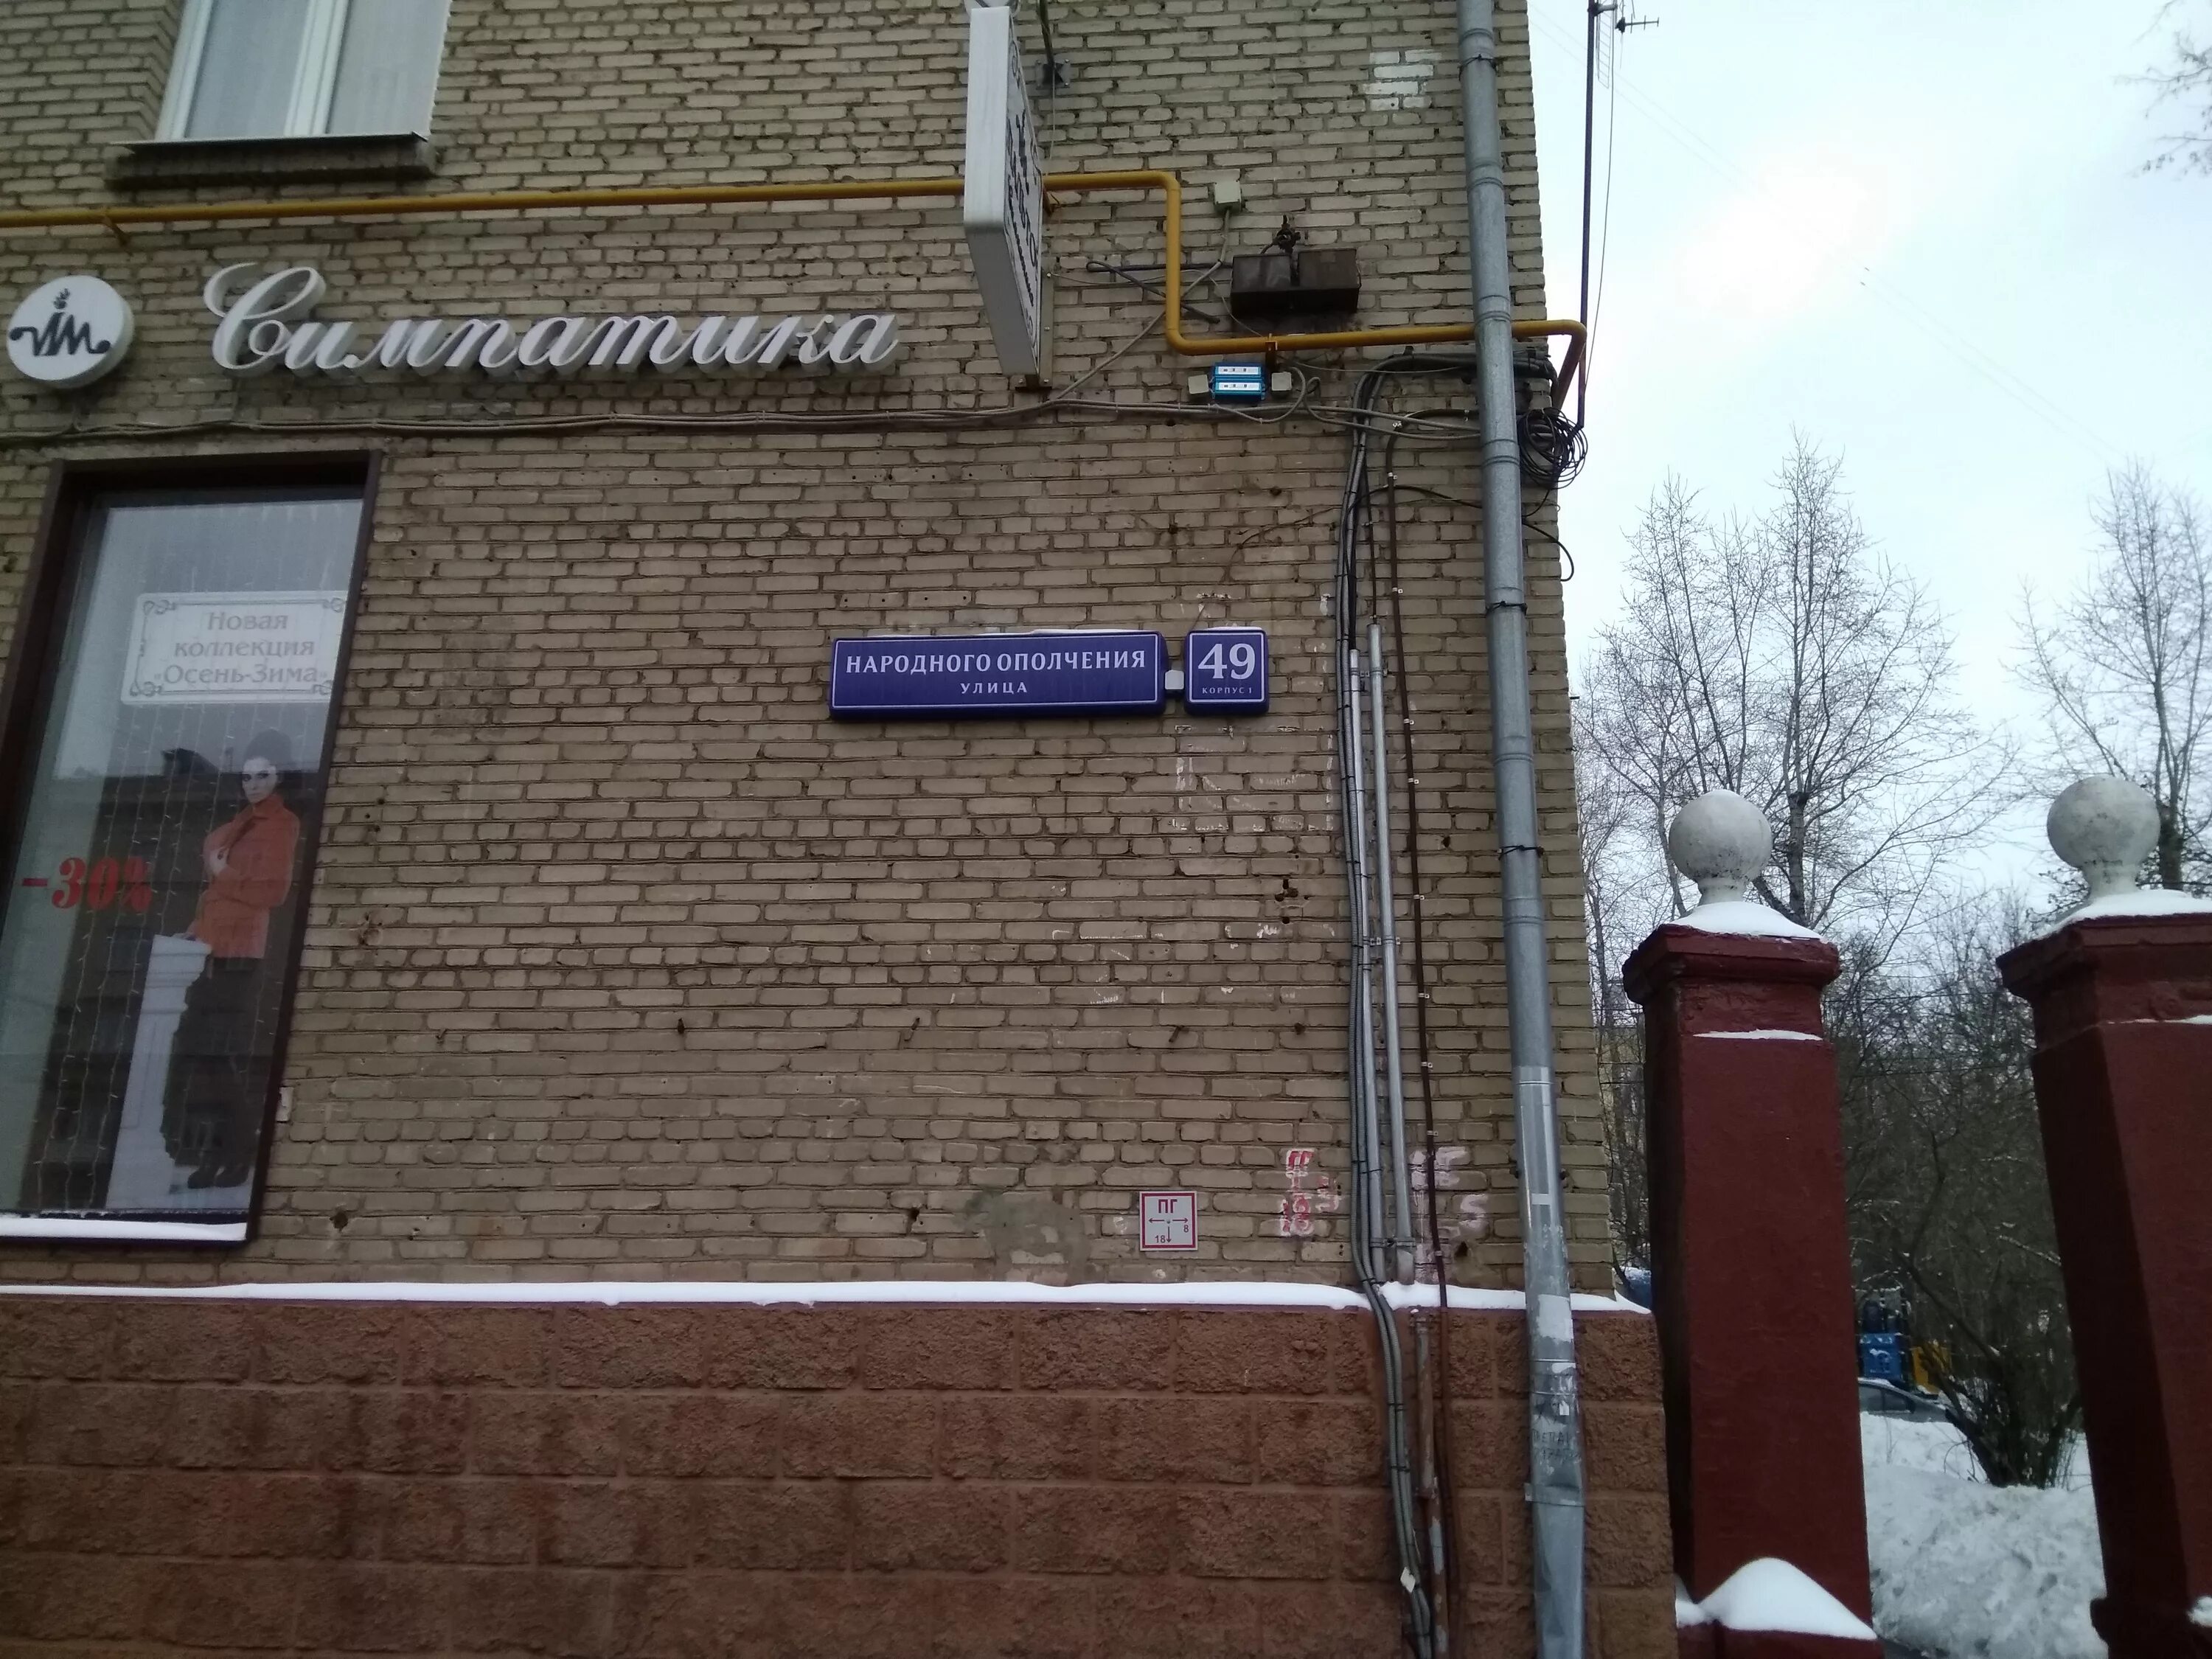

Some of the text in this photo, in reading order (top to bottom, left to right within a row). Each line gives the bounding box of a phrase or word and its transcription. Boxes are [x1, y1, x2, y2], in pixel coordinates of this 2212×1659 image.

[203, 262, 899, 374] Симпатика
[207, 612, 289, 630] Новая
[174, 640, 316, 658] коллекция
[846, 650, 1146, 675] НАРОДНОГО ОПОЛЧЕНИЯ
[1197, 643, 1256, 680] 49
[960, 681, 1028, 695] УЛИЦА
[1202, 686, 1253, 695] КОРПУС 1
[1158, 1199, 1178, 1214] ПГ
[1183, 1225, 1189, 1233] 8
[1155, 1235, 1166, 1243] 18
